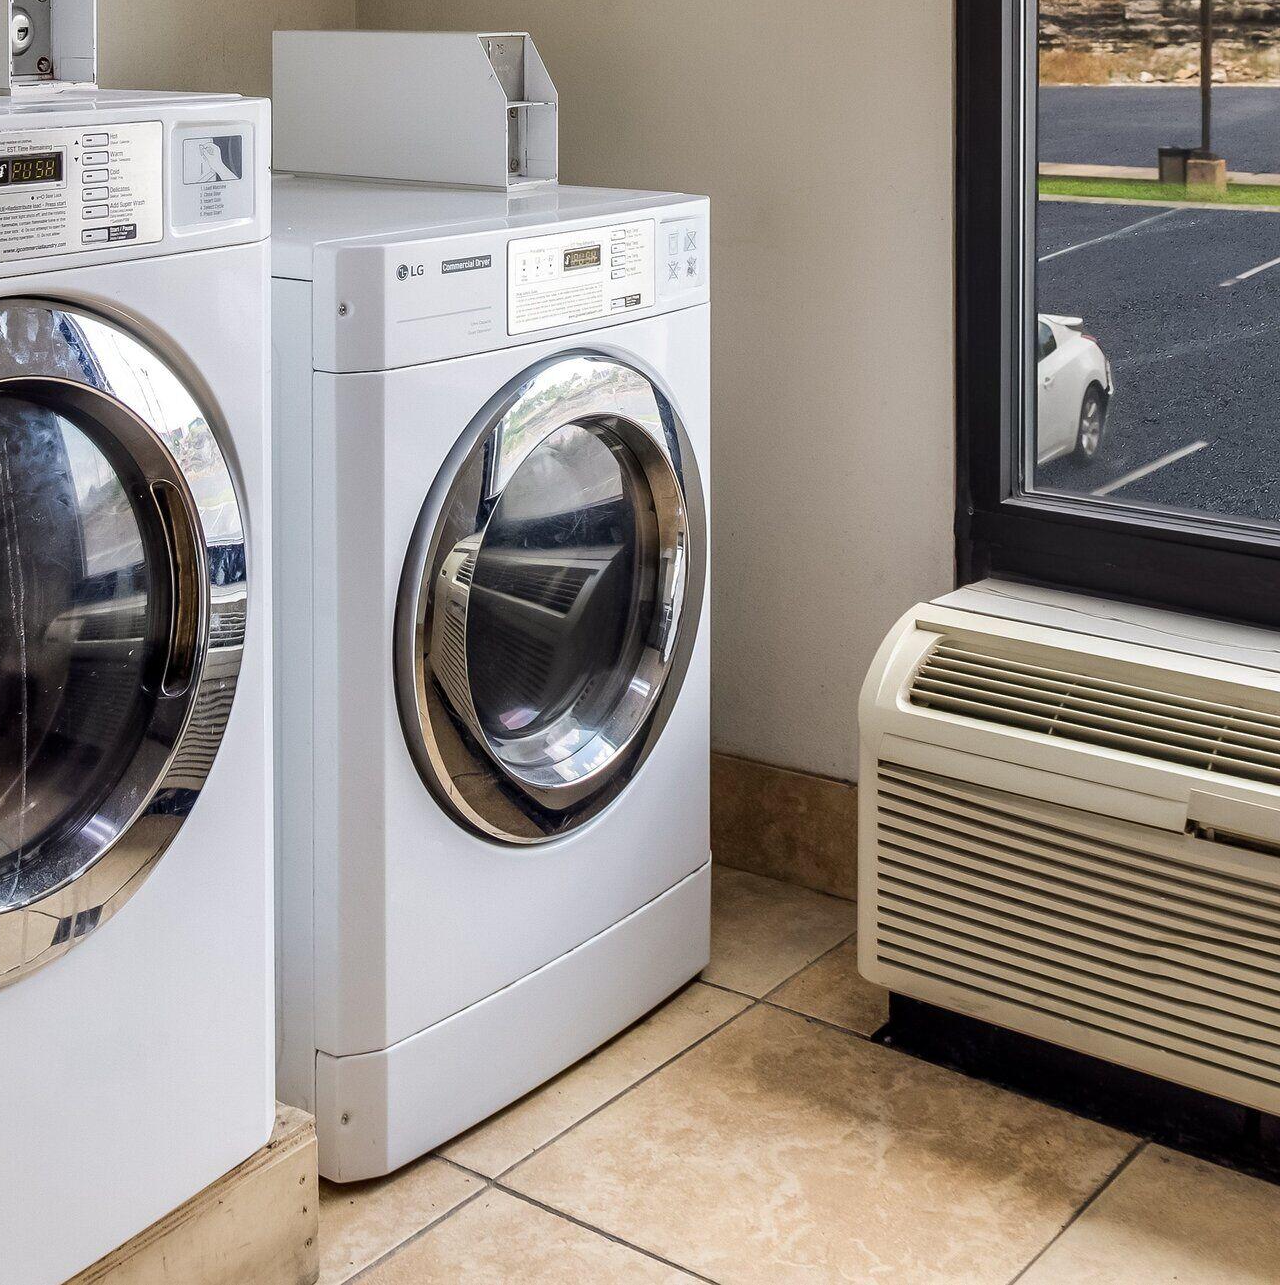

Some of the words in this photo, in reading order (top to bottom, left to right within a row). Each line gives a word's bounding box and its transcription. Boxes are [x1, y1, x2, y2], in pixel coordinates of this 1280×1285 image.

[410, 265, 424, 276] LG
[442, 259, 475, 272] Commercial
[475, 257, 490, 267] Dryer
